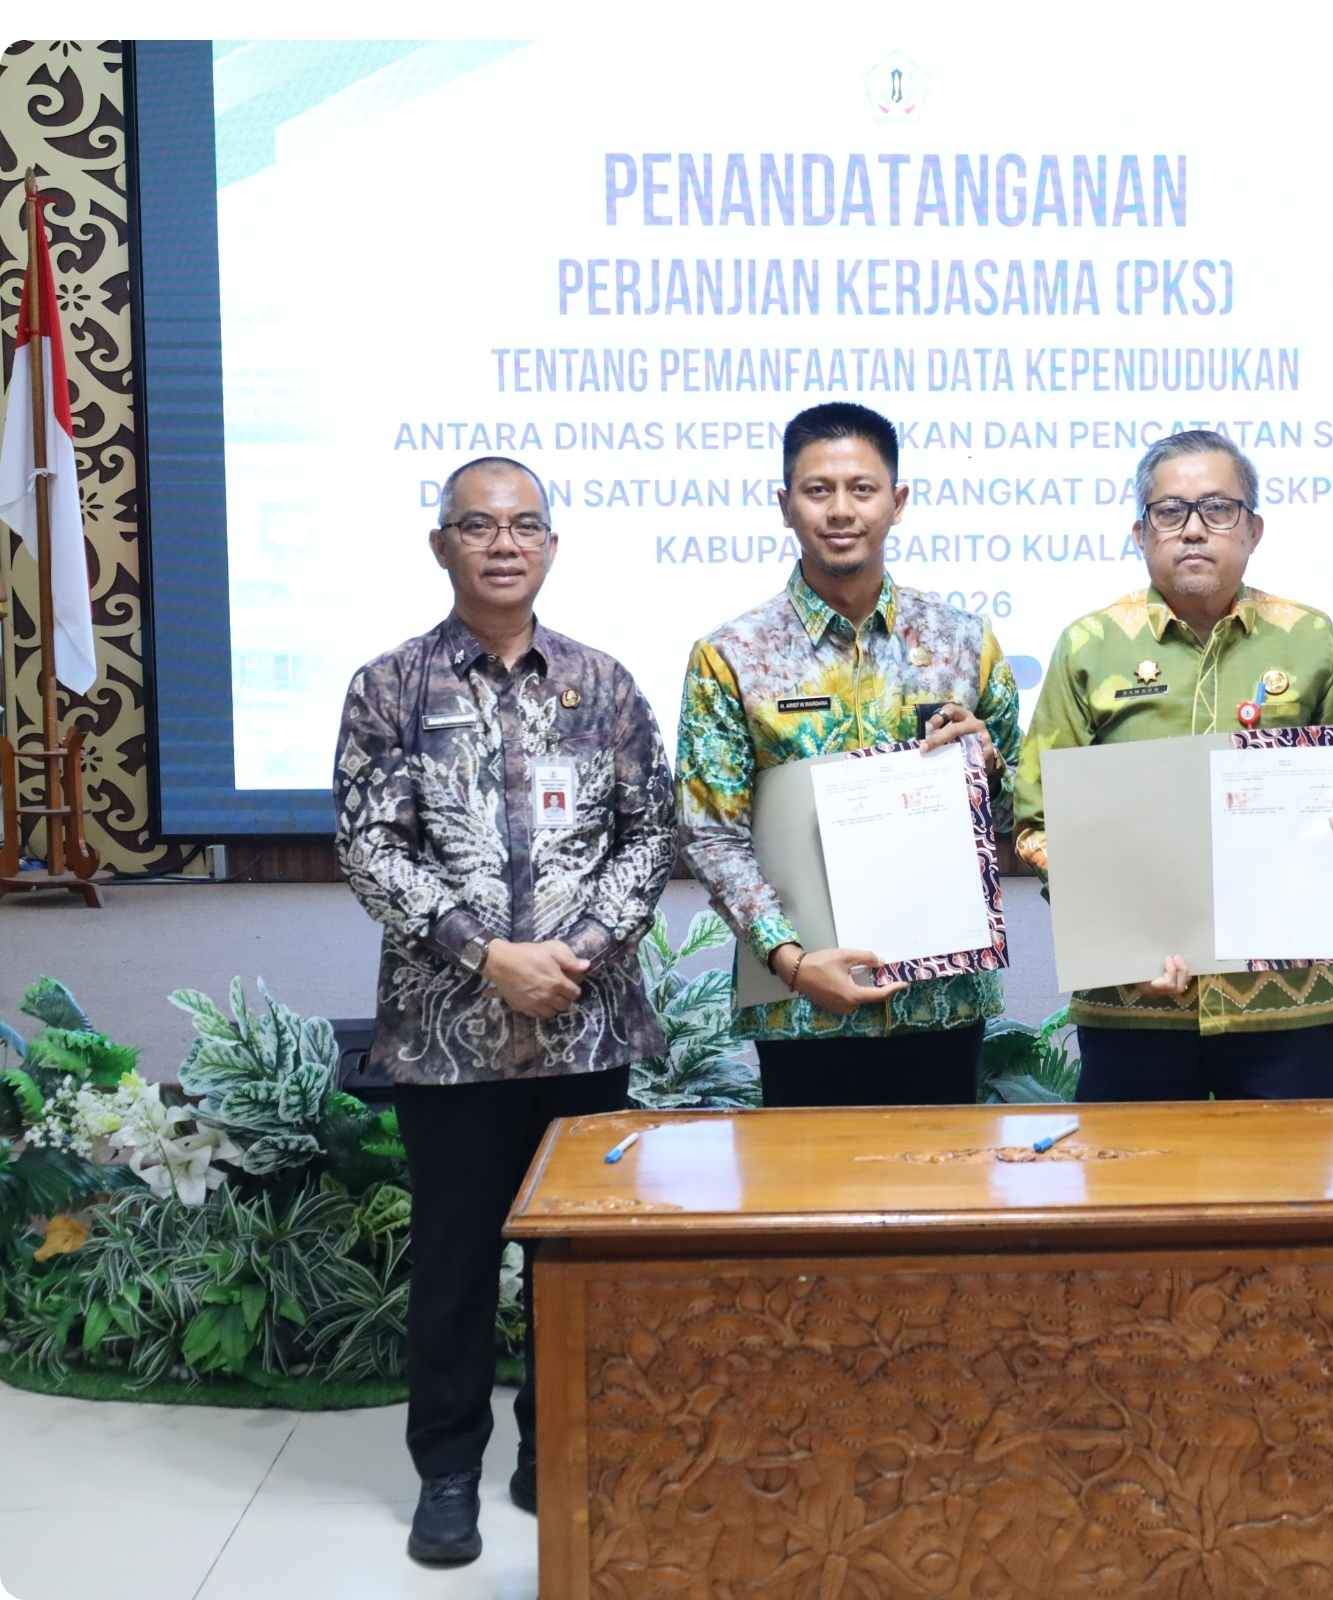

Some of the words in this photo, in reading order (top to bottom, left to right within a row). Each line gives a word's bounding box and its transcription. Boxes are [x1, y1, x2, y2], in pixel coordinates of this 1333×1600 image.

[604, 152, 1187, 228] PENANDATANGAN
[558, 258, 820, 316] PERJANJIAN
[836, 258, 1100, 316] KERJASAMA
[1115, 258, 1234, 316] (PKS)
[492, 348, 648, 392] TENTANG
[660, 348, 916, 392] PEMANFAATAN
[928, 348, 1014, 392] DATA
[1026, 348, 1299, 392] KEPENDUDUKAN
[394, 422, 543, 450] ANTARA
[555, 422, 664, 450] DINAS
[984, 421, 1058, 448] DAN
[584, 479, 729, 507] SATUAN
[884, 534, 1012, 562] BARITO
